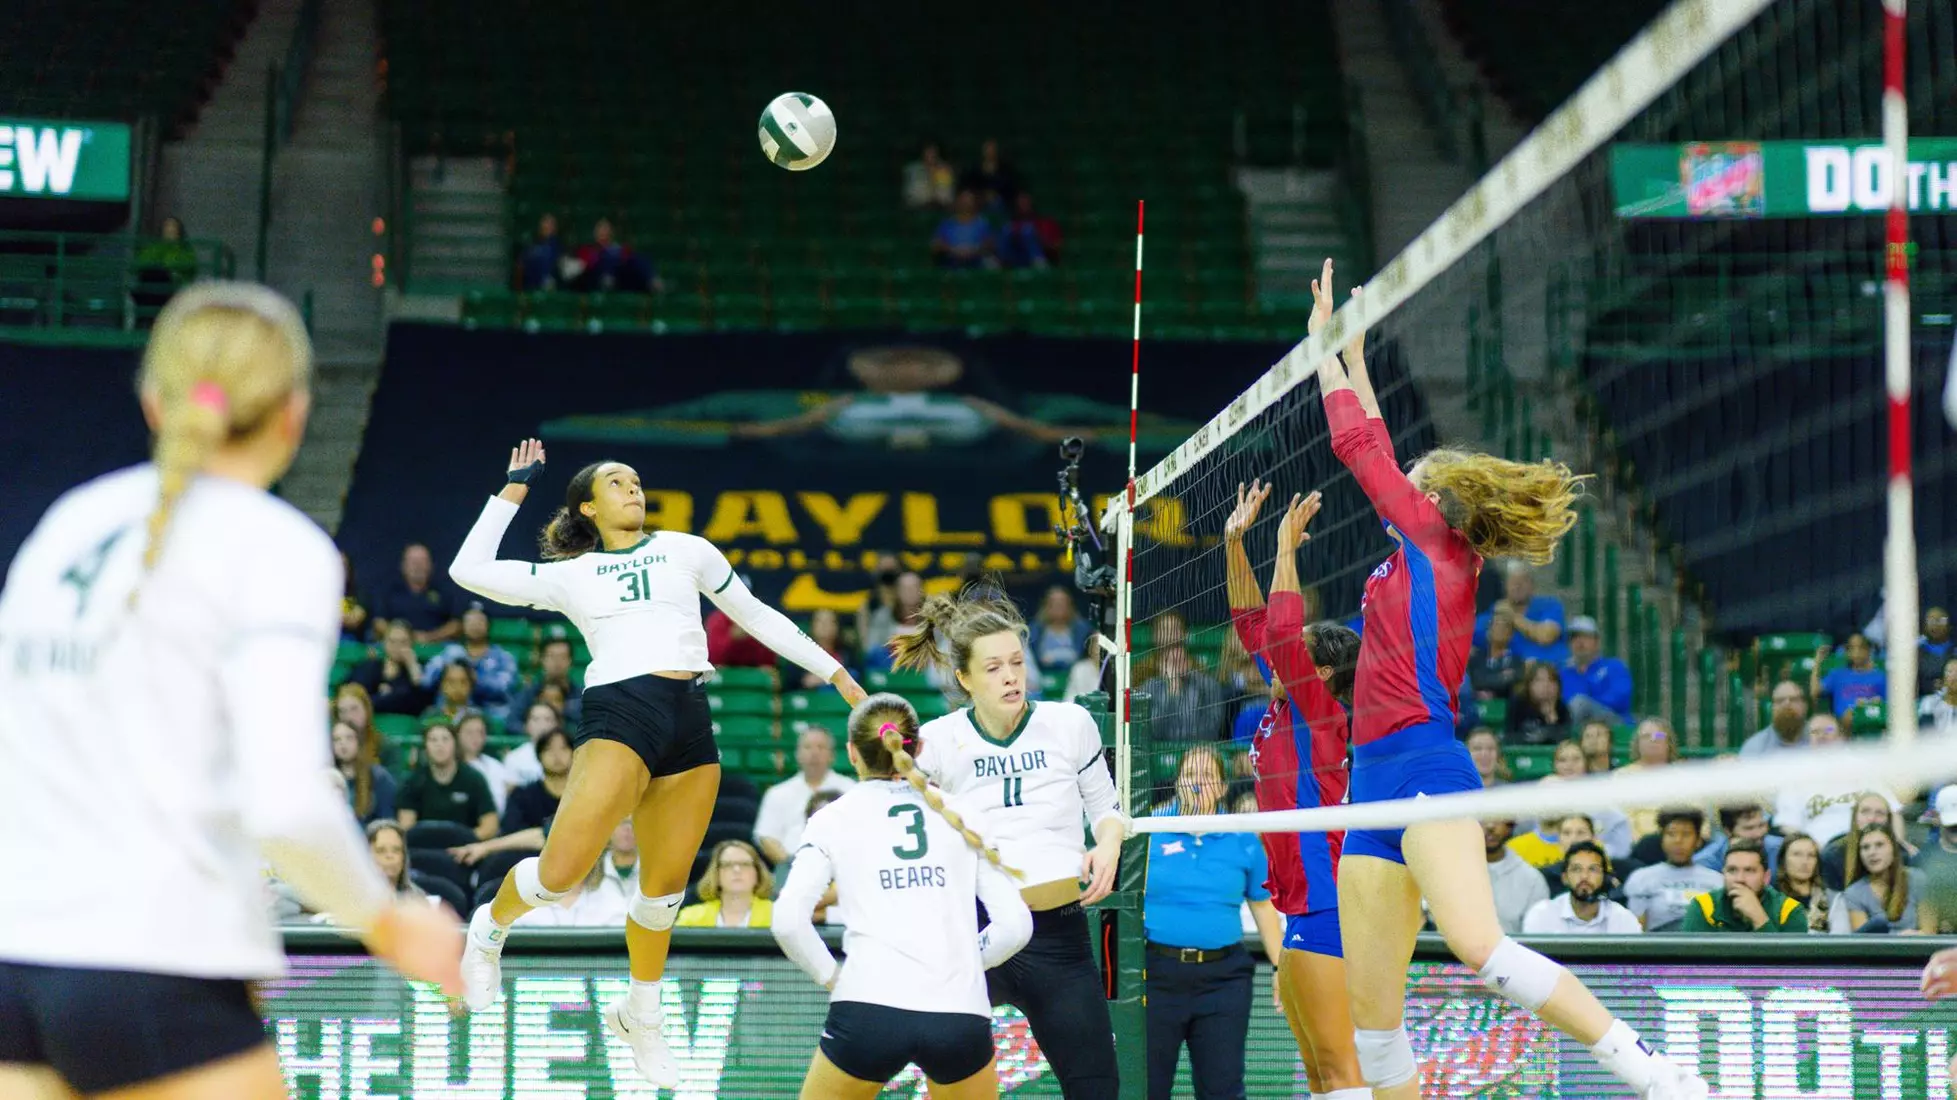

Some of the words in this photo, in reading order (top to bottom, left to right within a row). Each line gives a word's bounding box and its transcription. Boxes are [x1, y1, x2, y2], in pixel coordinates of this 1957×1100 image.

[1806, 147, 1895, 212] DO
[596, 555, 667, 576] BAYLOR
[617, 569, 651, 602] 31
[973, 749, 1048, 777] BAYLOR
[1003, 777, 1023, 808] 11
[887, 803, 928, 860] 3
[879, 866, 946, 890] BEARS
[276, 1018, 400, 1100] HE
[1653, 986, 1851, 1100] DO
